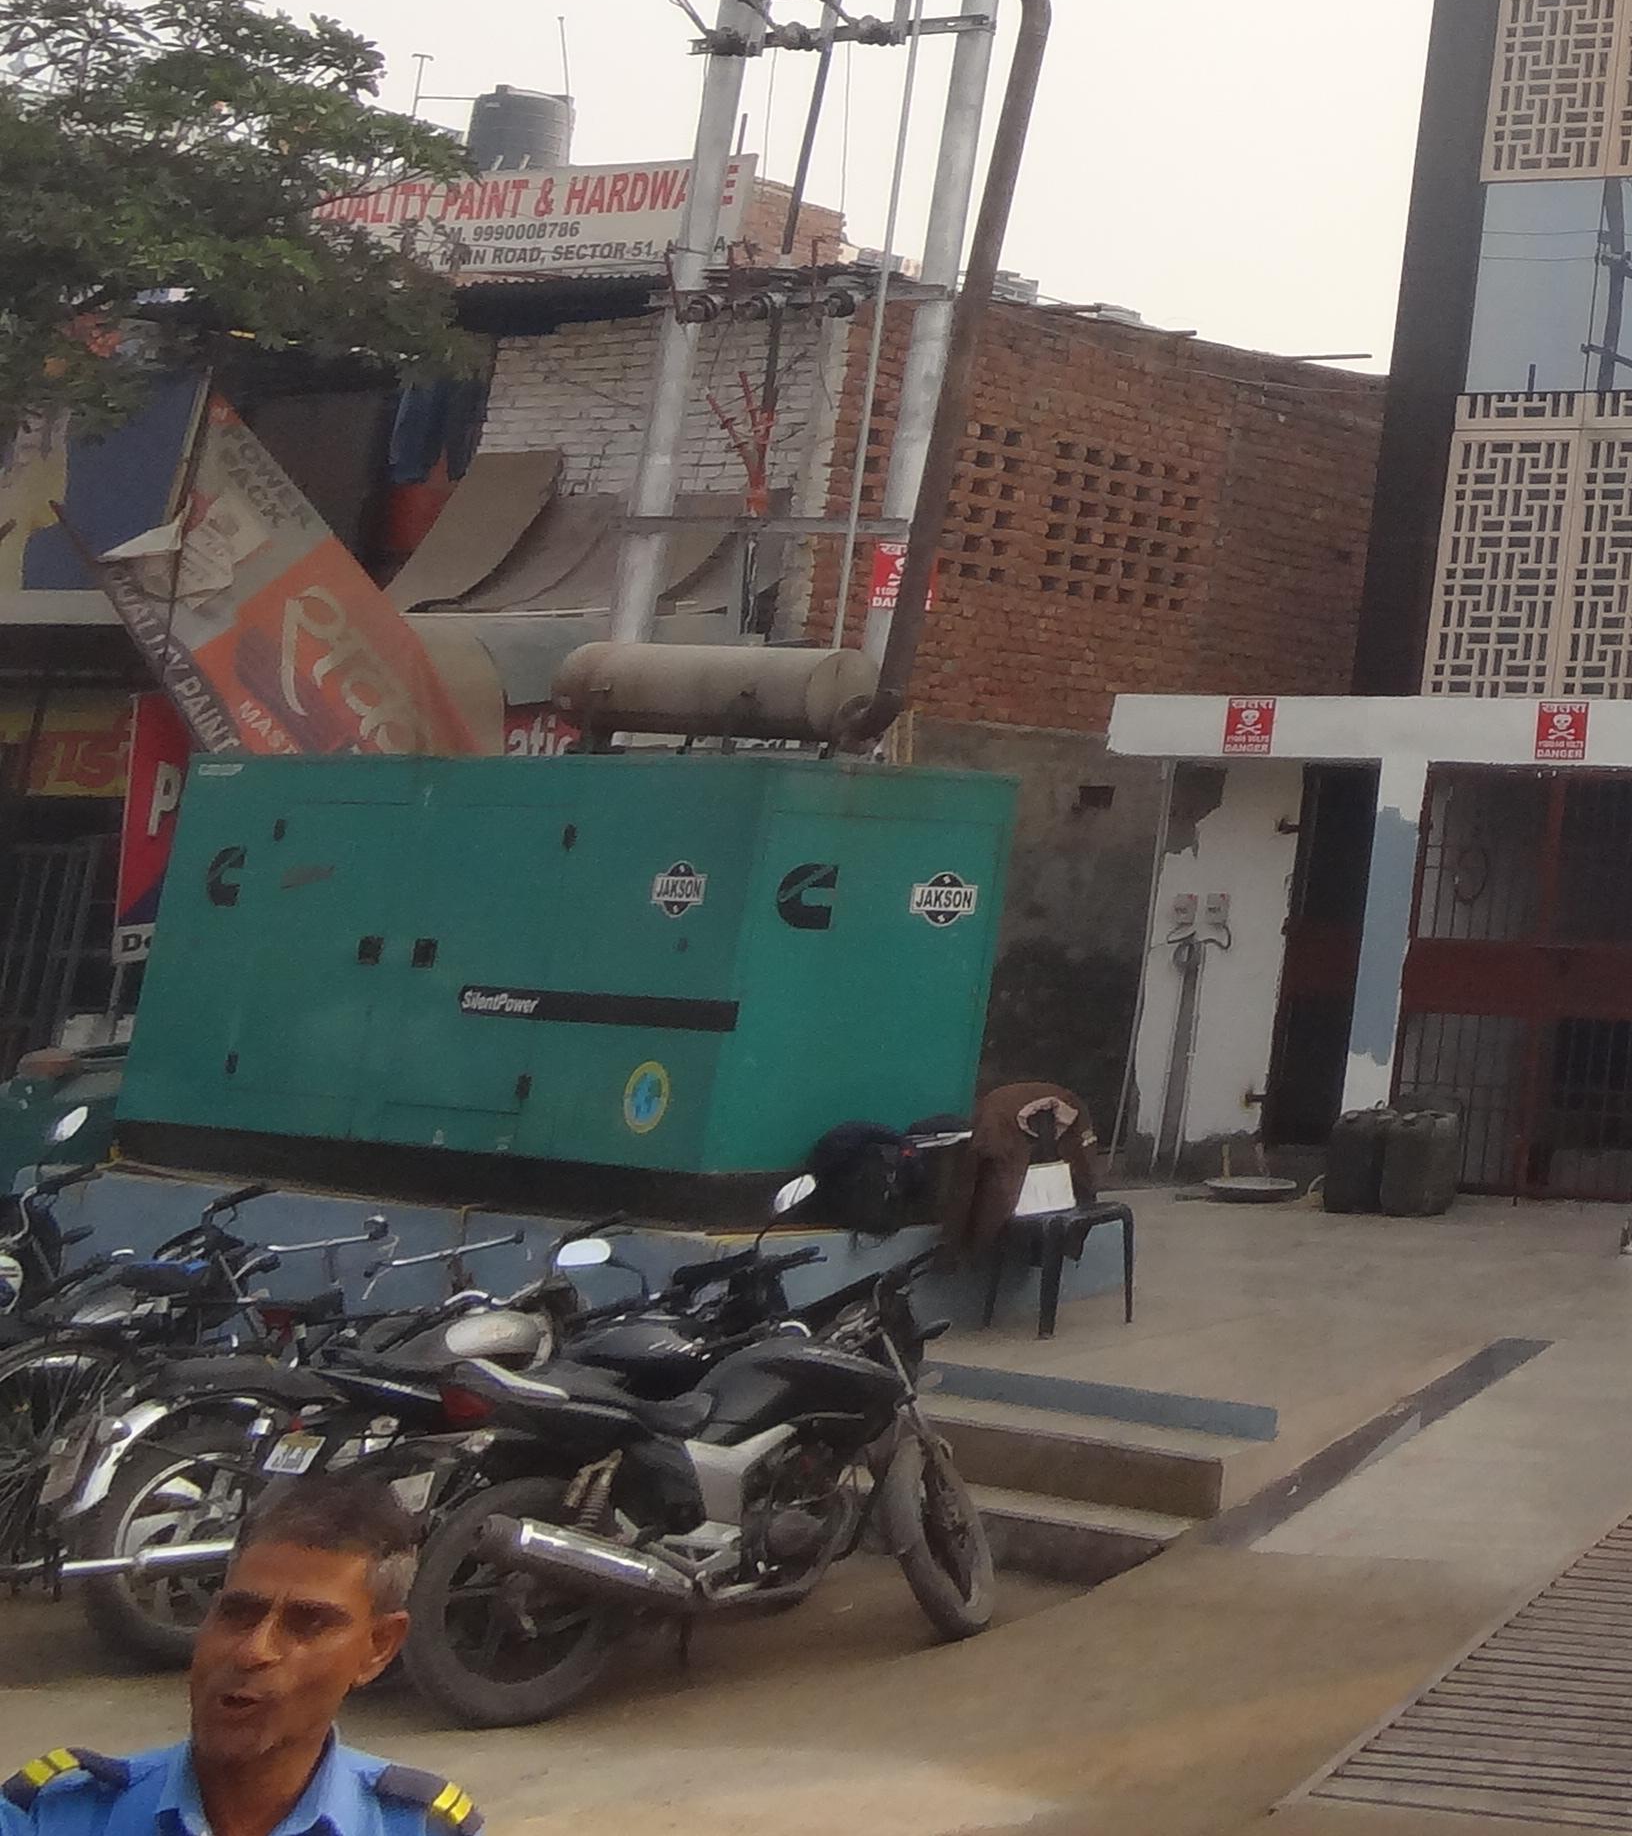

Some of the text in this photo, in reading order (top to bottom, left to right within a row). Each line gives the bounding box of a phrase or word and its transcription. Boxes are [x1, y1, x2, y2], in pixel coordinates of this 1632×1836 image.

[439, 178, 529, 221] PAINT
[534, 176, 554, 218] &
[563, 163, 740, 216] HARDWAE
[472, 220, 581, 243] 9990008786
[1224, 743, 1269, 753] DANGER
[1536, 749, 1583, 759] DANGER
[656, 878, 703, 899] JAKSON
[915, 889, 973, 909] JAKSON
[460, 989, 541, 1015] SilentPower
